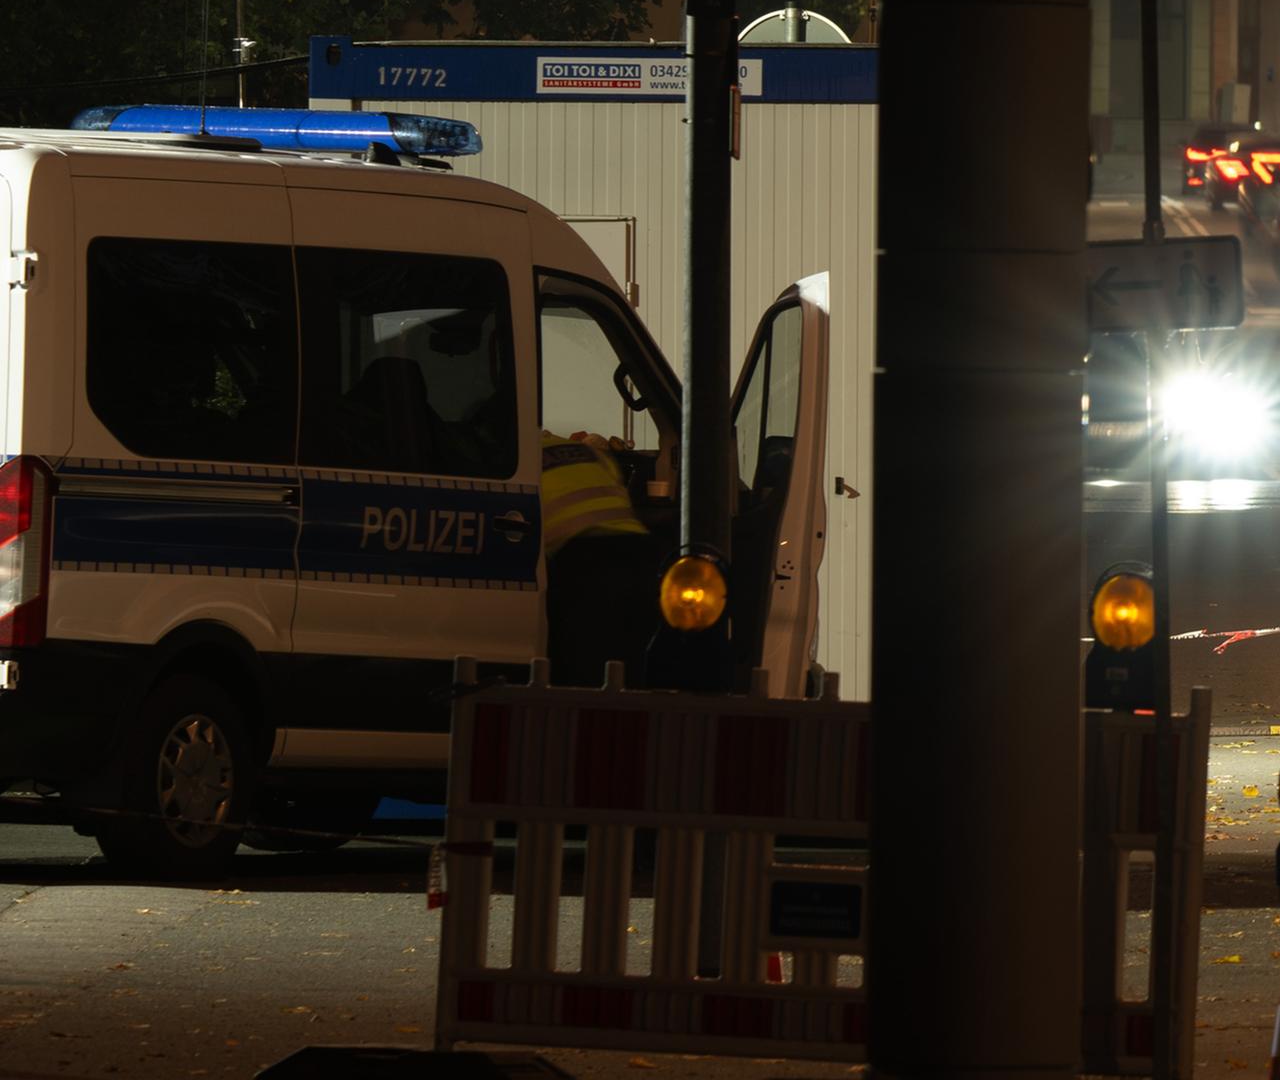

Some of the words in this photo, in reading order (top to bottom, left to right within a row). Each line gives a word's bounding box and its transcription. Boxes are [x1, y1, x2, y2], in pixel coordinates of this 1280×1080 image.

[379, 66, 449, 88] 17772
[544, 65, 569, 77] TOI
[572, 65, 596, 77] TOI
[597, 65, 607, 77] &
[610, 65, 640, 78] DIXI
[360, 505, 486, 555] POLIZEI
